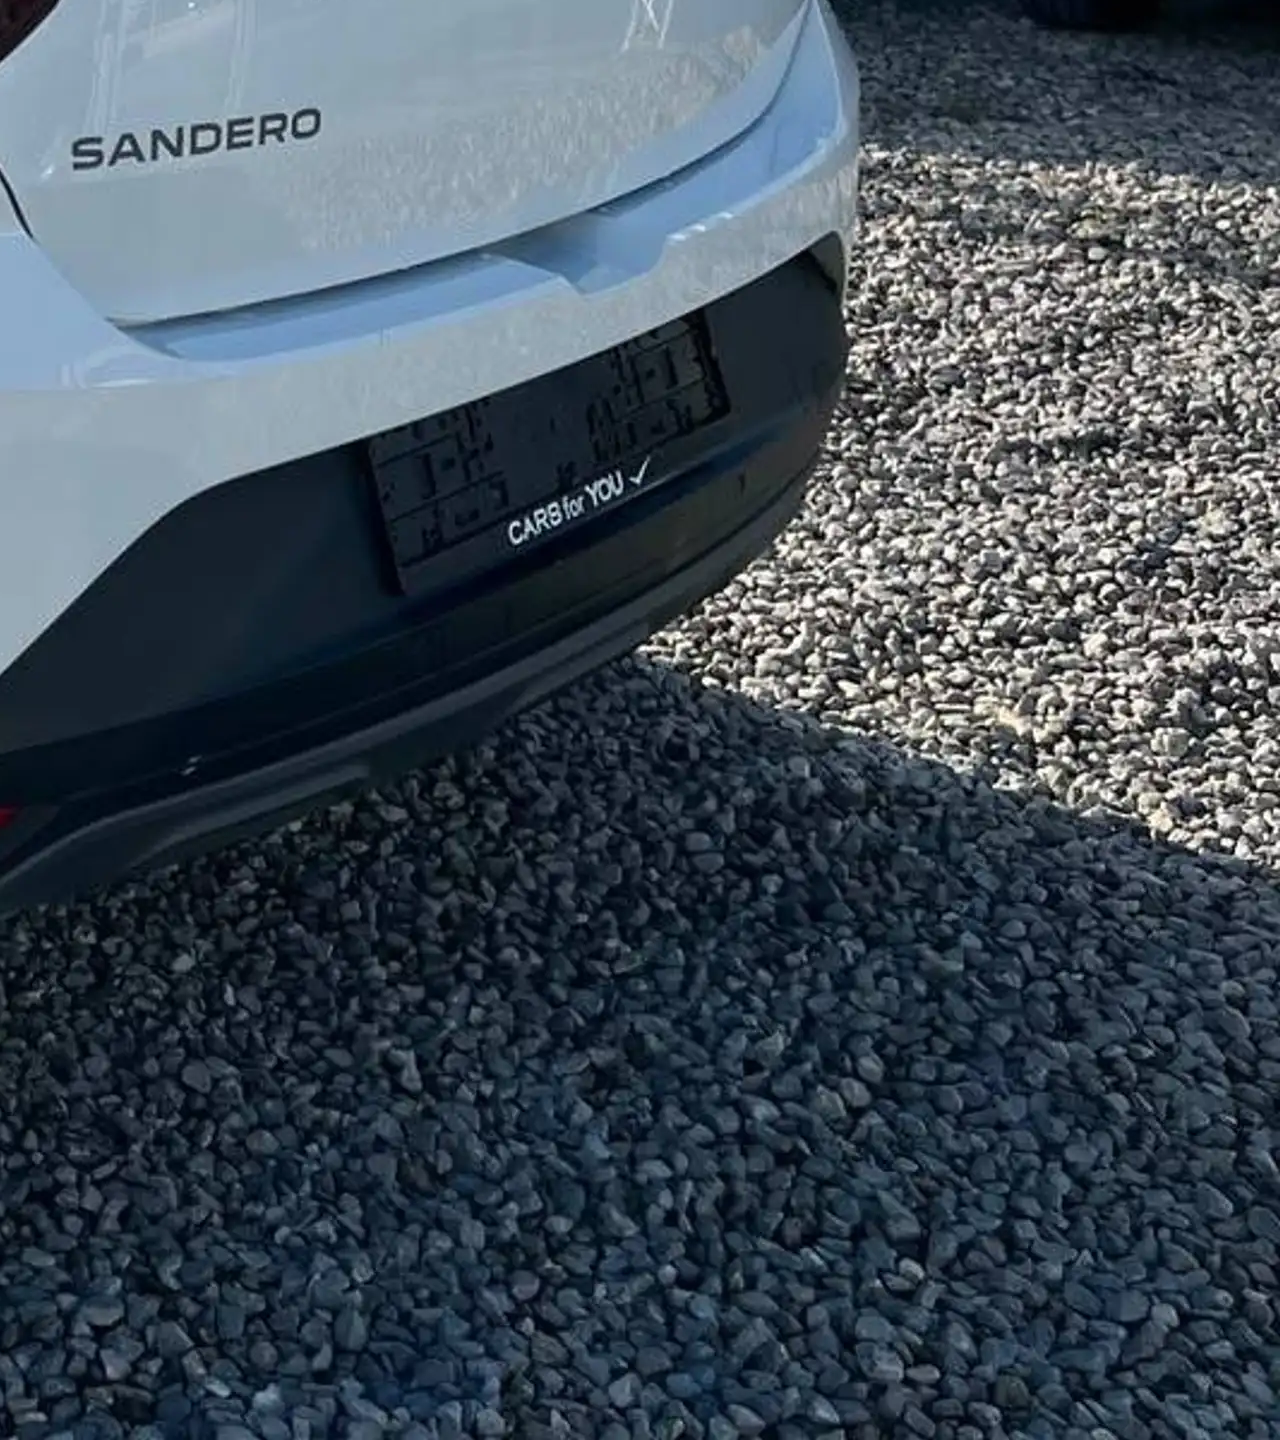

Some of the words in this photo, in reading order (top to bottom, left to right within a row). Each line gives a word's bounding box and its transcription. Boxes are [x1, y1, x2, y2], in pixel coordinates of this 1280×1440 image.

[72, 108, 321, 171] SANDERO
[562, 495, 585, 520] for
[584, 470, 624, 507] YOU
